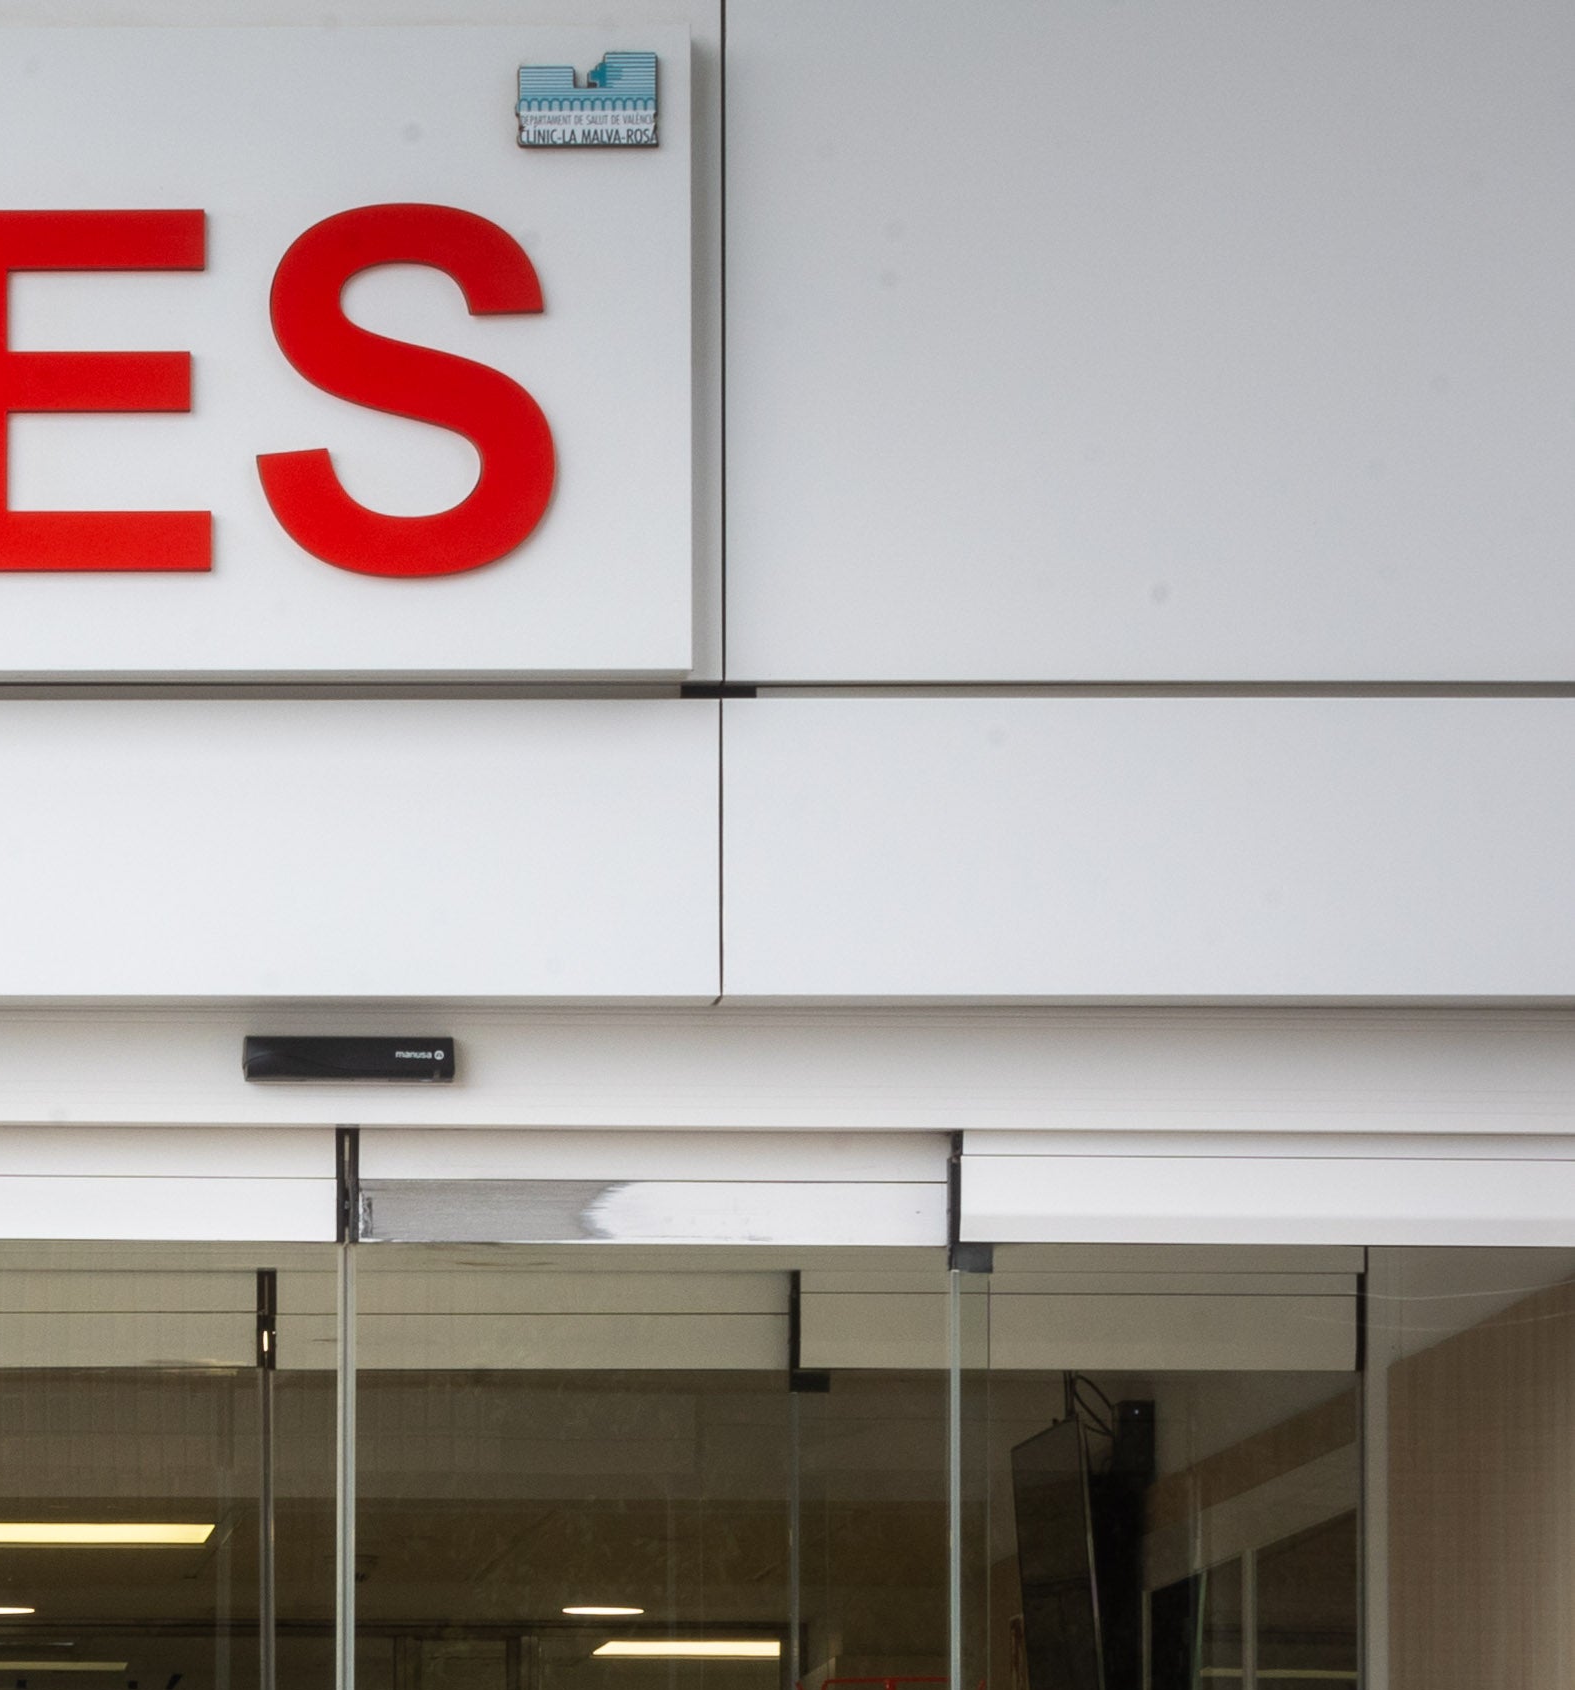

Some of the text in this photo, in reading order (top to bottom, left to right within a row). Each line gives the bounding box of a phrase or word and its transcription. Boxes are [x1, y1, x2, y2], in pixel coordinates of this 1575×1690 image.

[574, 114, 584, 125] DE
[586, 114, 608, 126] SALUT
[611, 114, 621, 126] DE
[395, 1051, 432, 1059] manusa
